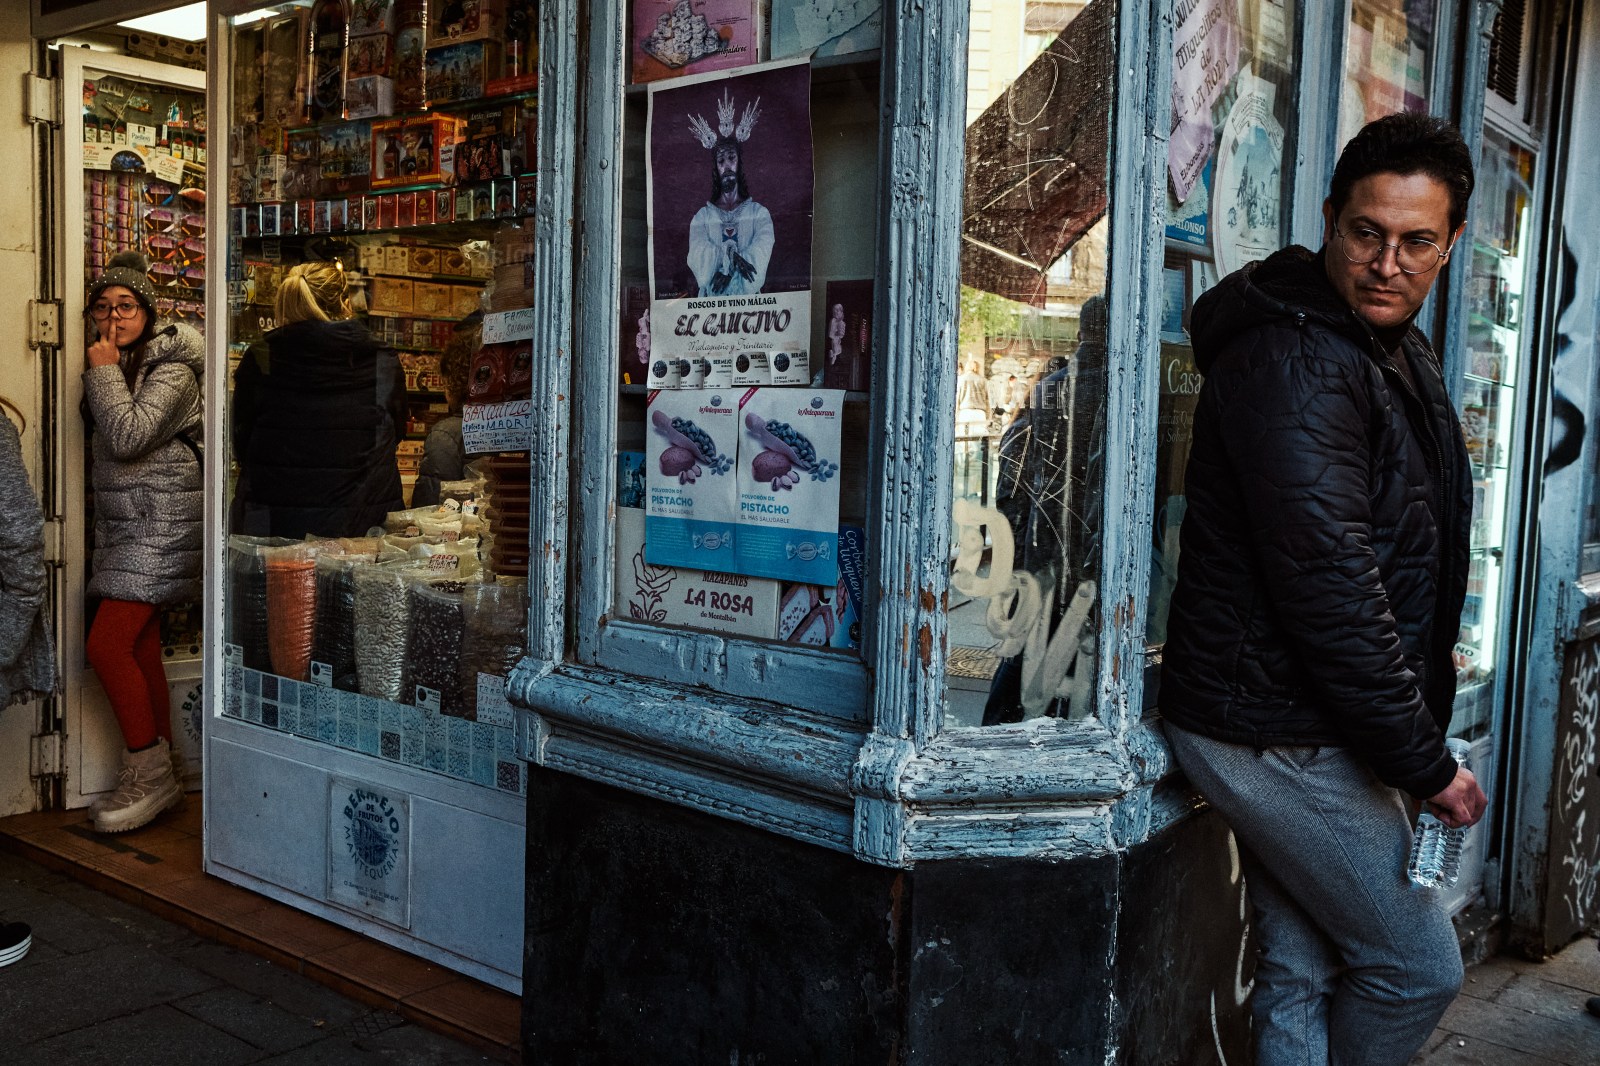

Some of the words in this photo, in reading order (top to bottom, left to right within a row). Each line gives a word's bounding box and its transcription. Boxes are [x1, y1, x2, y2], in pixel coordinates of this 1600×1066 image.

[687, 301, 716, 310] ROSCOS
[718, 300, 727, 308] DE
[729, 299, 746, 307] VINO
[747, 296, 777, 306] MÁLAGA
[674, 314, 700, 336] EL
[702, 309, 791, 336] CAUTIVO
[736, 337, 774, 351] Trinitario
[1167, 358, 1201, 394] Casa
[651, 496, 693, 507] PISTACHO
[741, 502, 789, 515] PISTACHO
[759, 516, 789, 524] SALUDABLE
[702, 572, 749, 588] MAZAPANES
[684, 588, 706, 607] LA
[710, 591, 753, 616] ROSA
[1456, 645, 1474, 657] NO
[344, 788, 400, 834] BERMEJO
[367, 803, 375, 813] DE
[358, 810, 383, 824] FRUTOS
